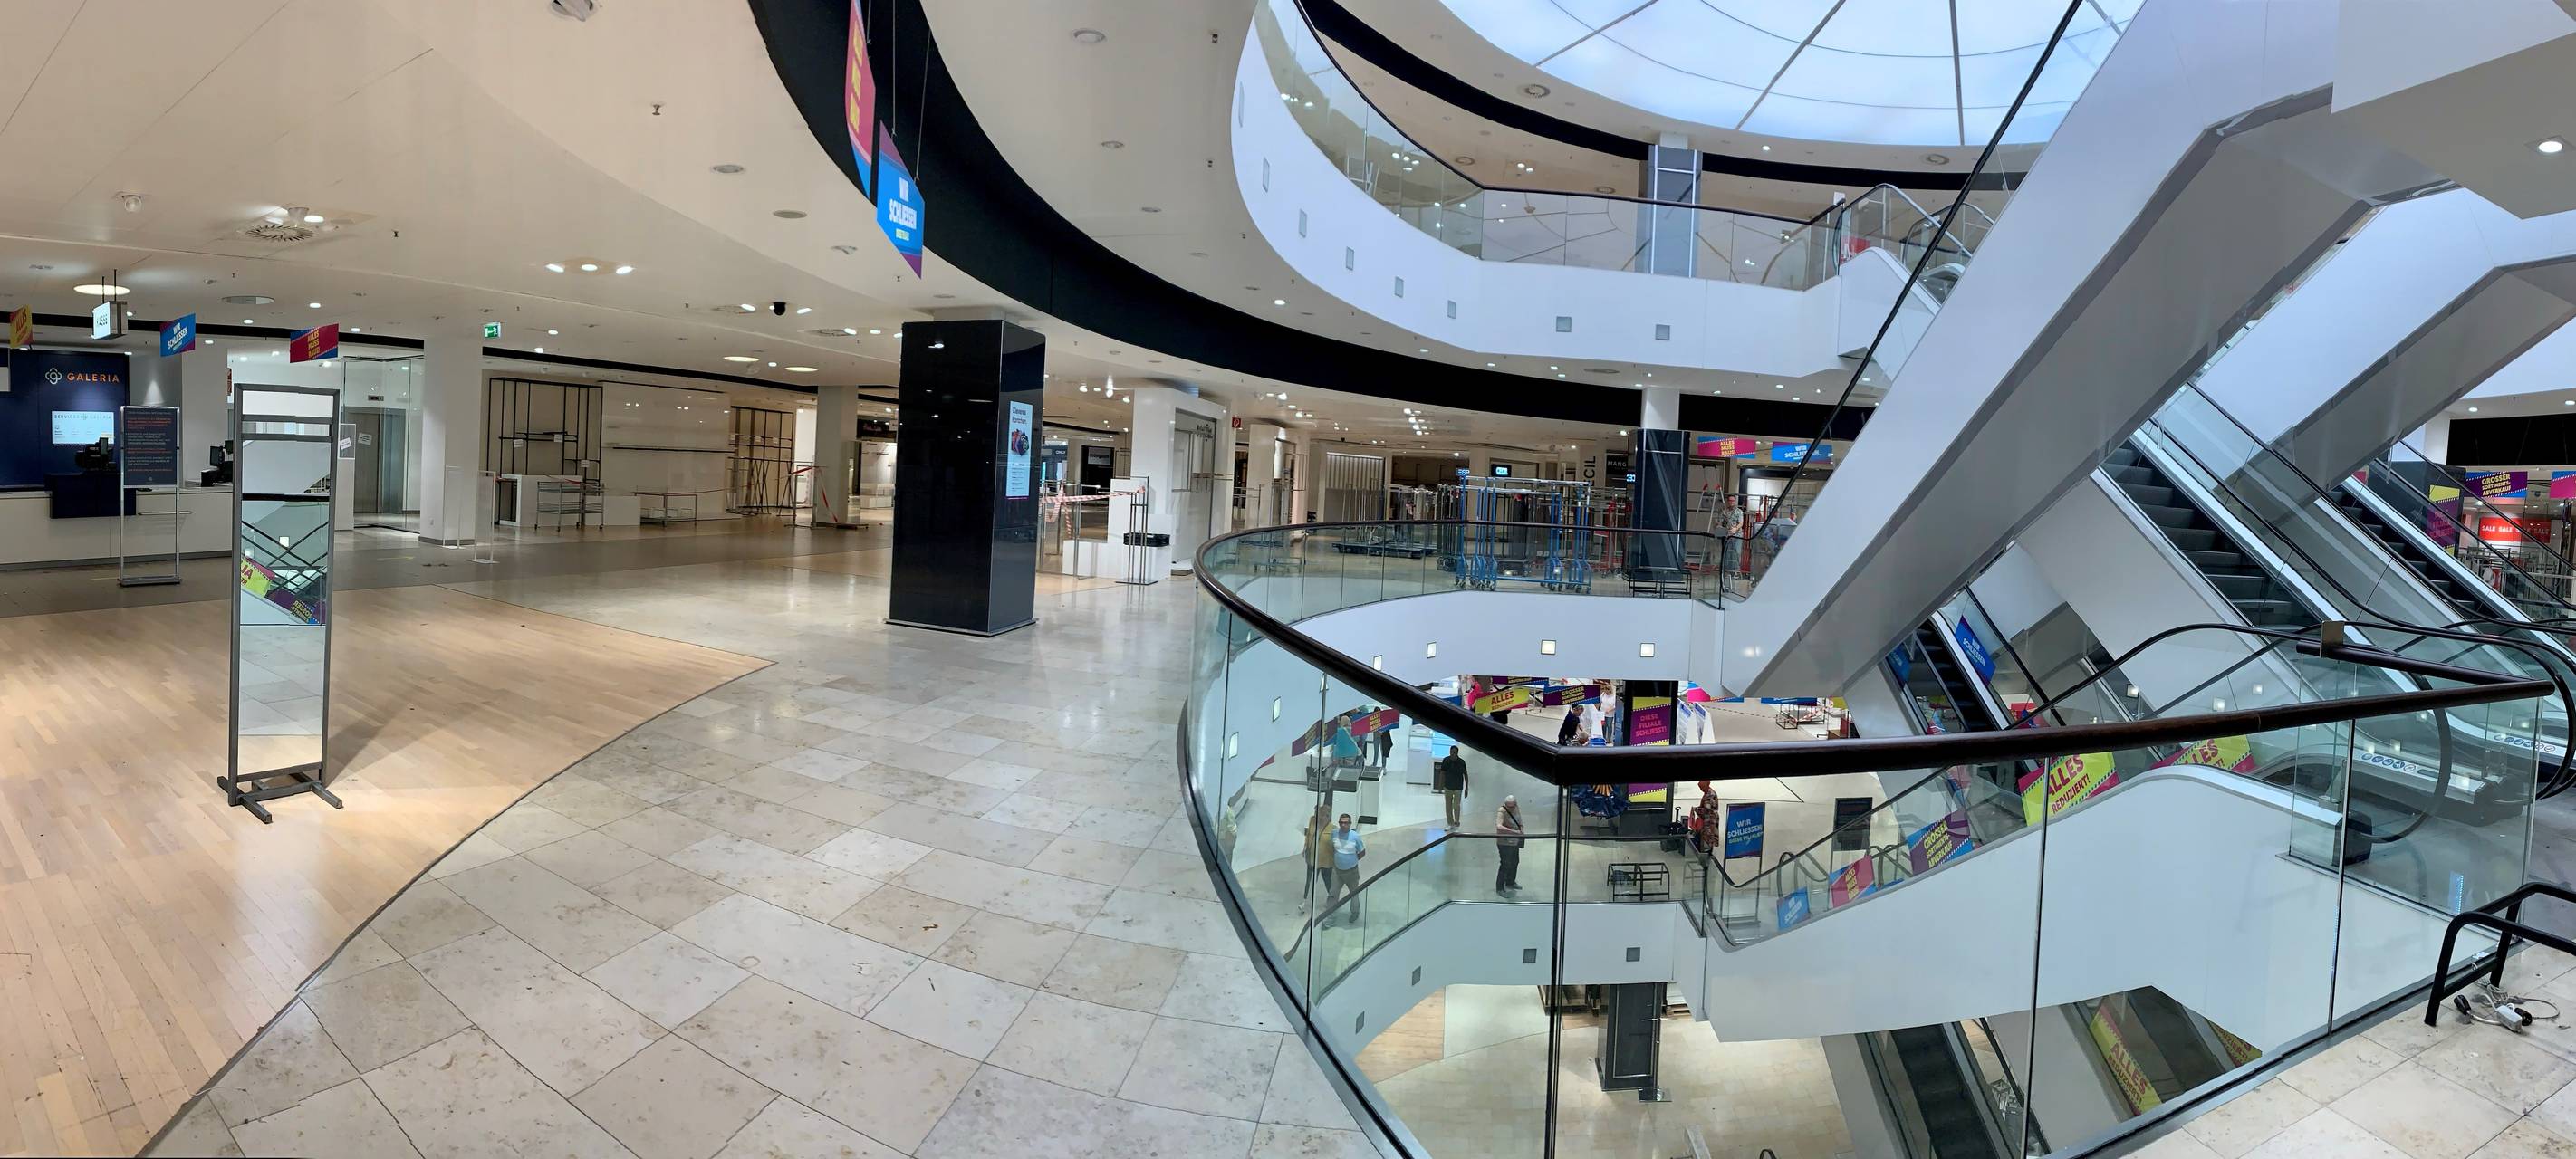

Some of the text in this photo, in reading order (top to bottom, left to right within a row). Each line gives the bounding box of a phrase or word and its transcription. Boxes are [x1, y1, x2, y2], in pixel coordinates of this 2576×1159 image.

[67, 372, 120, 383] GALERIA
[2481, 473, 2511, 485] GROSSER
[1491, 691, 1514, 705] ALLES
[1640, 713, 1659, 721] DIESE
[1639, 720, 1662, 729] FILIALE
[1635, 725, 1667, 737] SCHLIESST!
[2051, 773, 2091, 814] REDUZIERT!
[1736, 819, 1752, 828] WIR
[1727, 824, 1763, 838] SCHLIESSEN
[2110, 1042, 2148, 1095] ALLES
